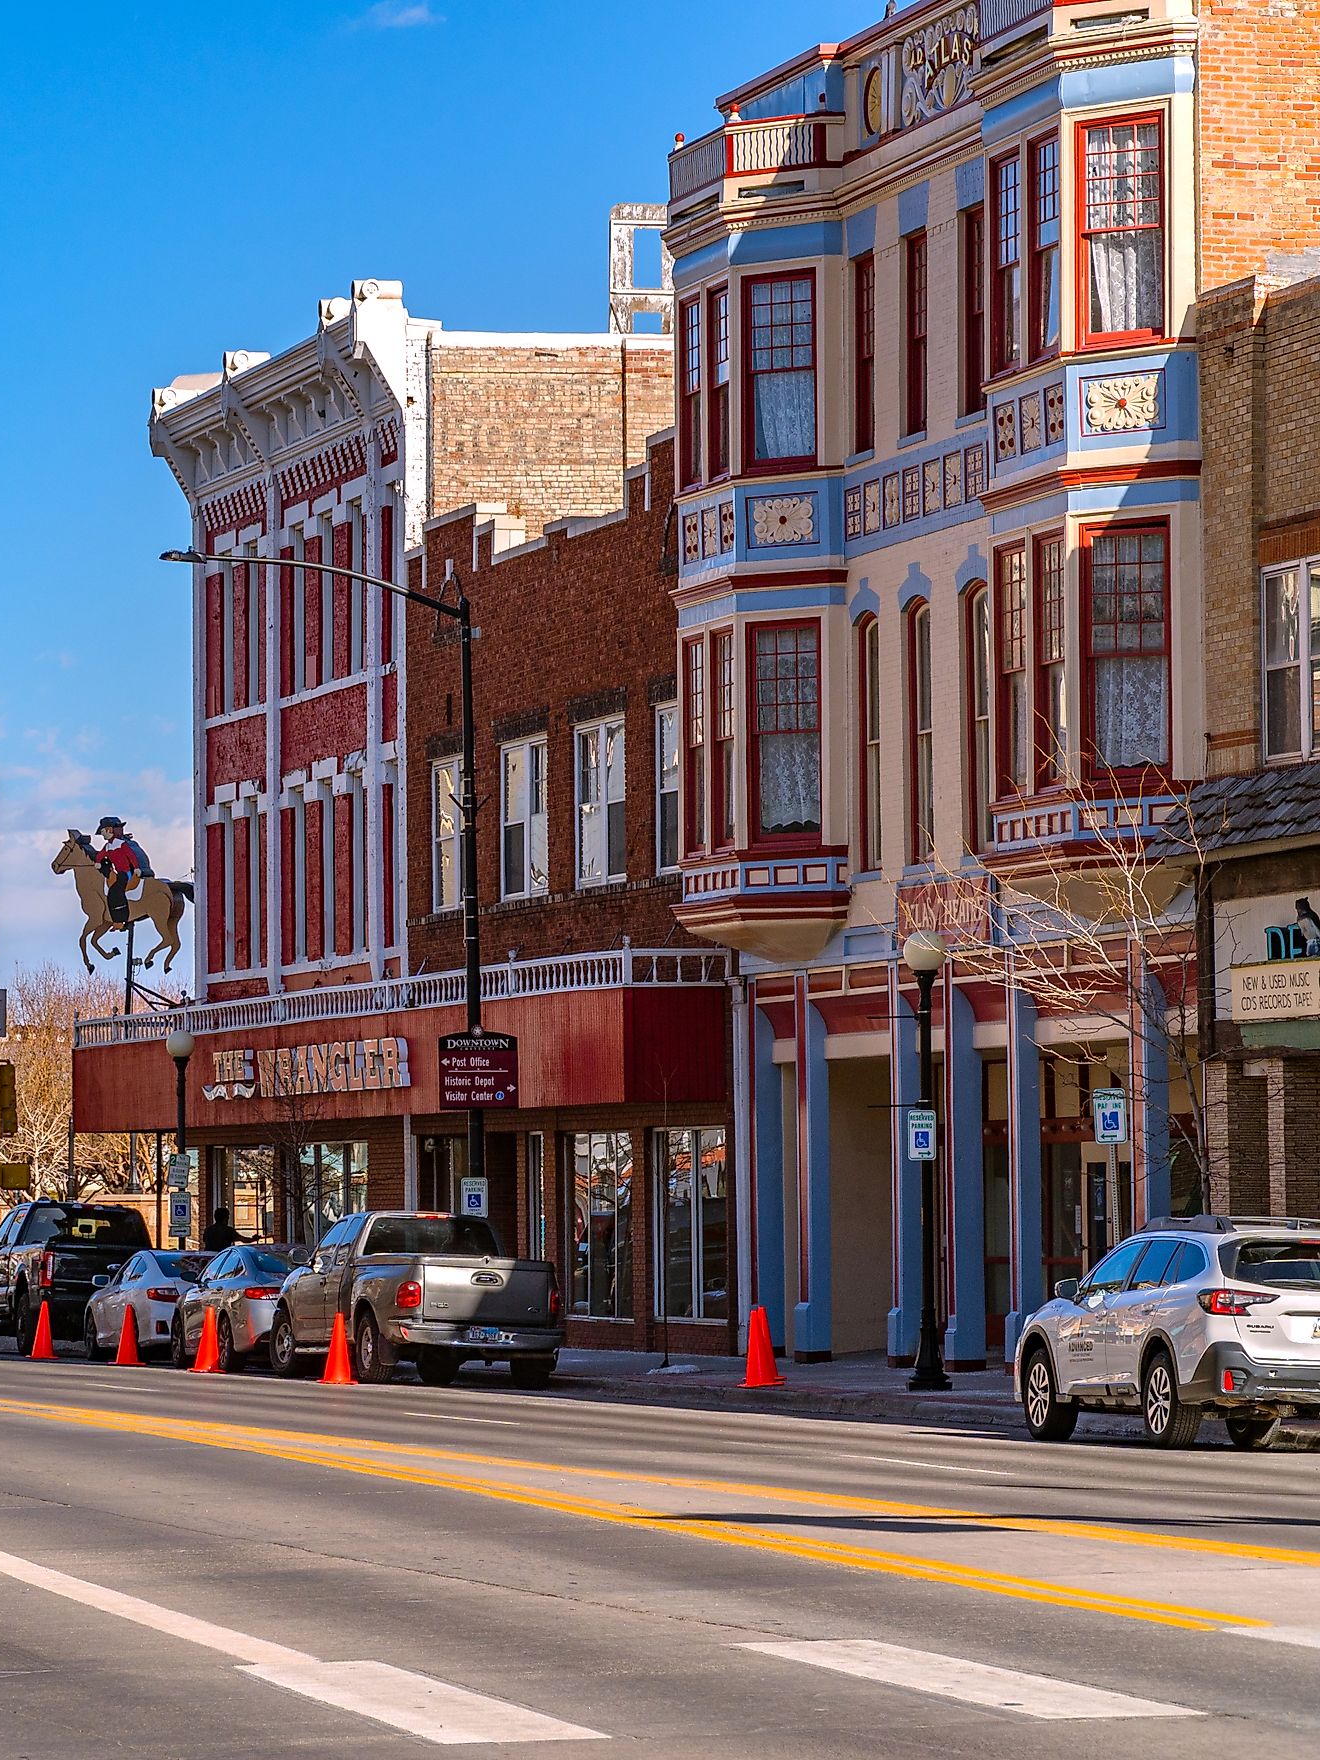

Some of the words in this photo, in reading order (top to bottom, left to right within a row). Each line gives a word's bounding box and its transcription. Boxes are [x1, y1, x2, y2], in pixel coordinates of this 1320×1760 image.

[925, 33, 972, 89] ATLAS
[1243, 976, 1259, 992] NEW
[1261, 975, 1267, 990] &
[1269, 974, 1287, 990] USED
[1289, 971, 1310, 988] MUSIC
[1259, 993, 1292, 1010] RECORDS
[1293, 991, 1313, 1007] TAPES
[447, 1038, 510, 1049] DOWNTOWN
[212, 1049, 254, 1083] THE
[257, 1036, 411, 1098] WRANGLER
[451, 1056, 467, 1067] Post
[469, 1056, 490, 1067] Office
[444, 1075, 472, 1086] Historic
[474, 1075, 495, 1088] Depot
[444, 1090, 468, 1101] Visitor
[471, 1090, 494, 1101] Center
[910, 1113, 935, 1121] RESERVED
[170, 1156, 177, 1165] 2
